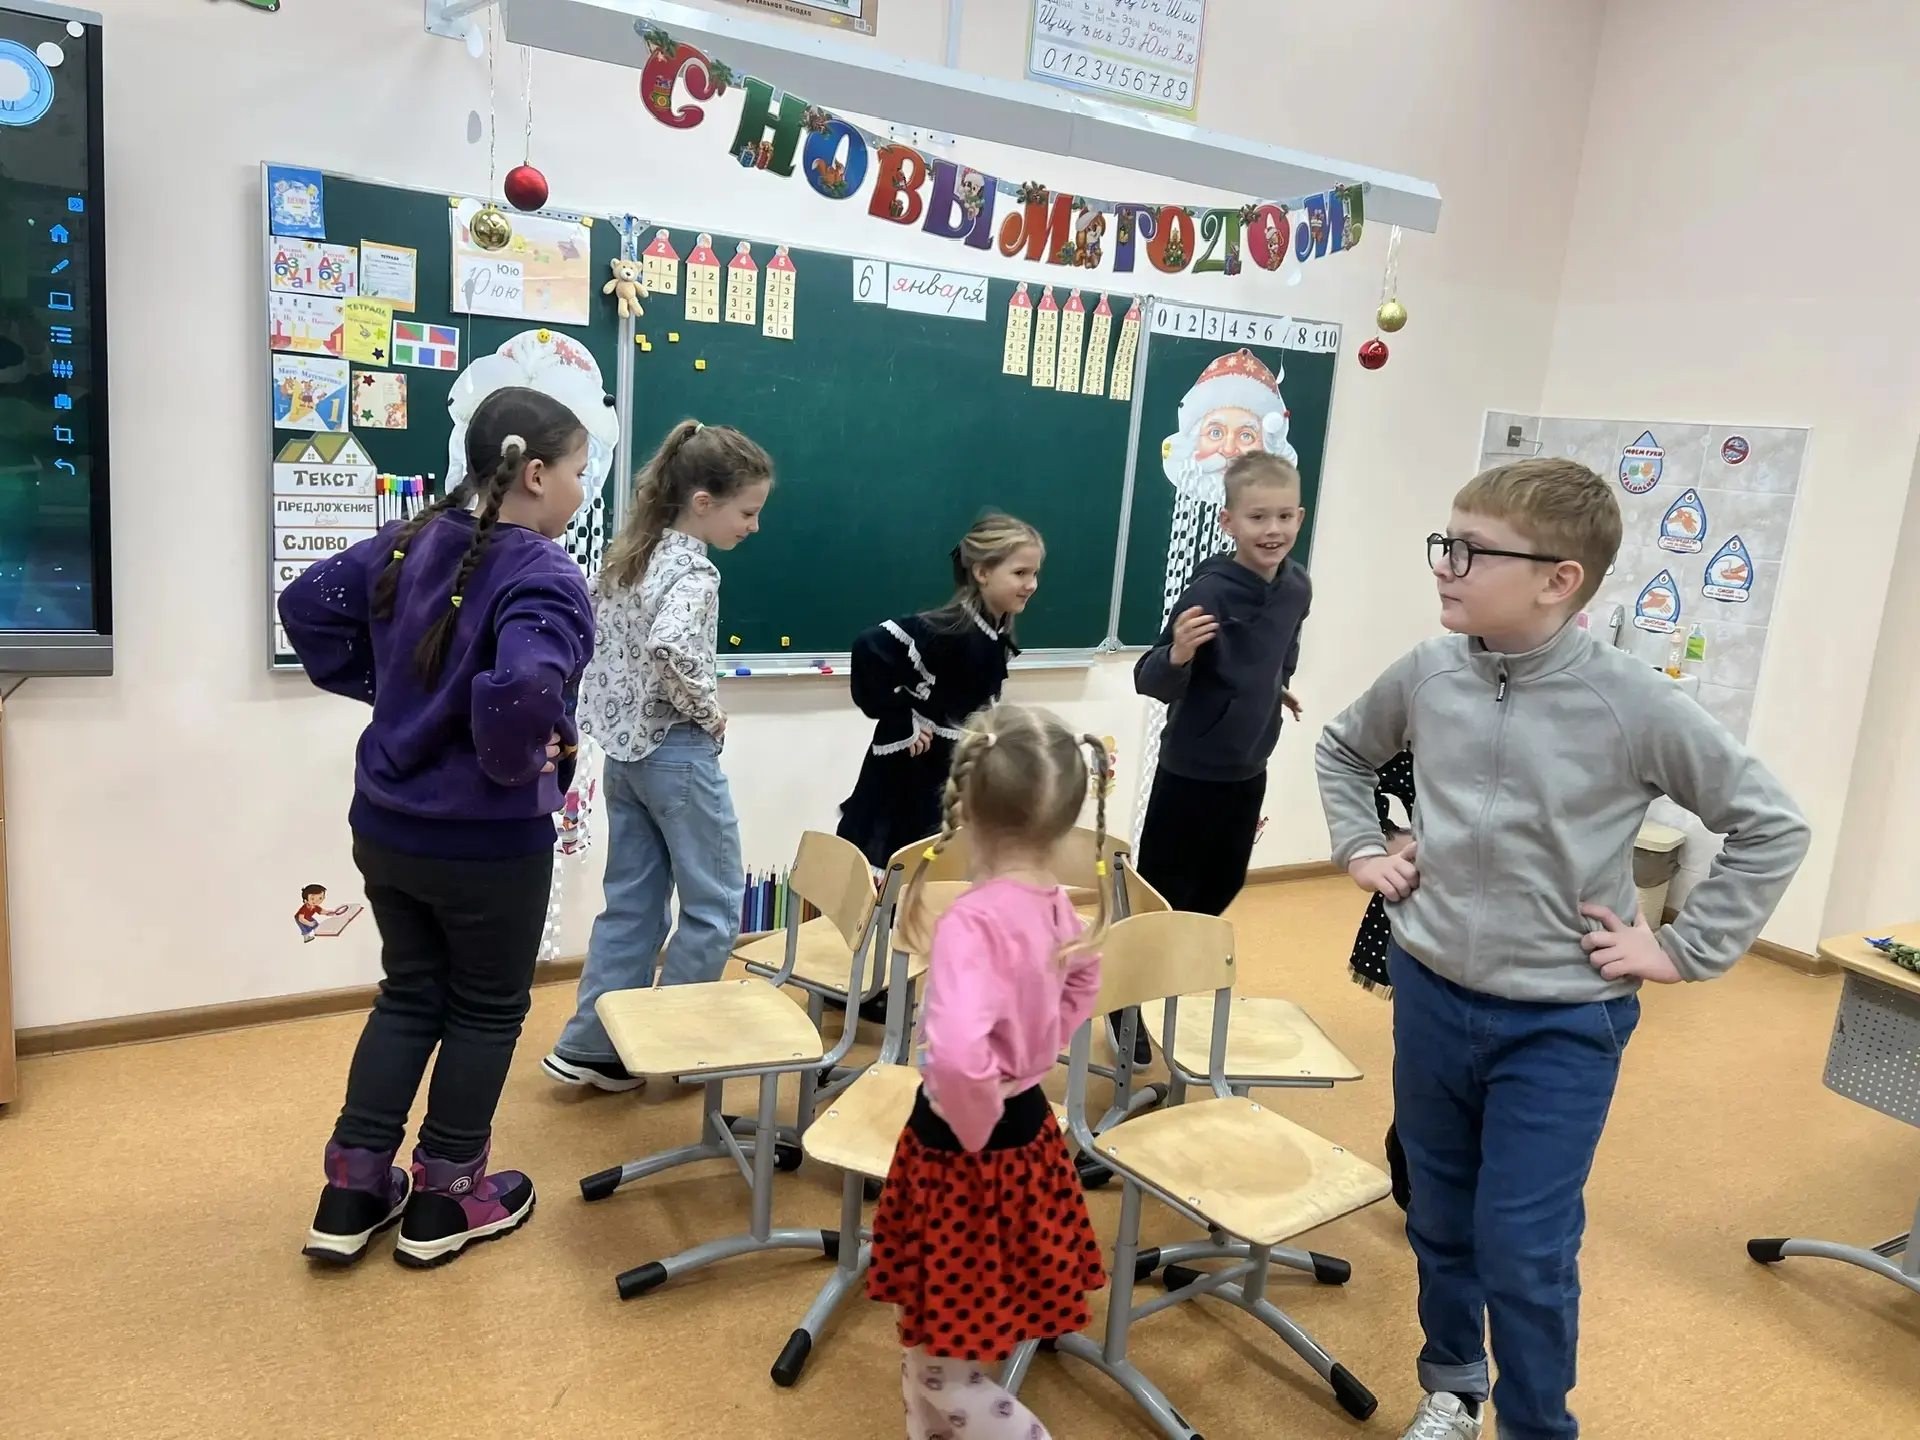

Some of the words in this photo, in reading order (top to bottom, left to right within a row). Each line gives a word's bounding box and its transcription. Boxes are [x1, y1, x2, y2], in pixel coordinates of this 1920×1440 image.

[784, 5, 812, 17] посадка
[641, 42, 716, 130] С
[729, 75, 1075, 265] НОВЫМ
[658, 244, 665, 252] 2
[699, 252, 706, 261] 3
[739, 256, 747, 264] 4
[778, 258, 785, 266] 5
[747, 274, 753, 282] 3
[859, 264, 874, 298] 6
[647, 279, 653, 287] 2
[691, 287, 697, 295] 2
[732, 285, 738, 293] 2
[784, 287, 790, 295] 3
[731, 299, 737, 307] 3
[768, 299, 774, 307] 3
[692, 306, 697, 314] 3
[730, 312, 736, 320] 4
[783, 315, 787, 323] 1
[782, 327, 787, 335] 0
[1157, 308, 1167, 327] 0
[1173, 312, 1180, 331] 1
[1187, 314, 1197, 333] 2
[1207, 317, 1217, 335] 3
[1229, 320, 1238, 338] 4
[1246, 321, 1257, 339] 5
[1264, 324, 1273, 342] 6
[1298, 327, 1307, 344] 8
[1322, 329, 1337, 348] 10
[293, 470, 358, 487] ТЕКСТ
[1687, 494, 1693, 502] 4
[277, 500, 374, 513] ПРЕДЛОЖЕНИЕ
[282, 534, 348, 551] СЛОВО
[1732, 541, 1738, 549] 5
